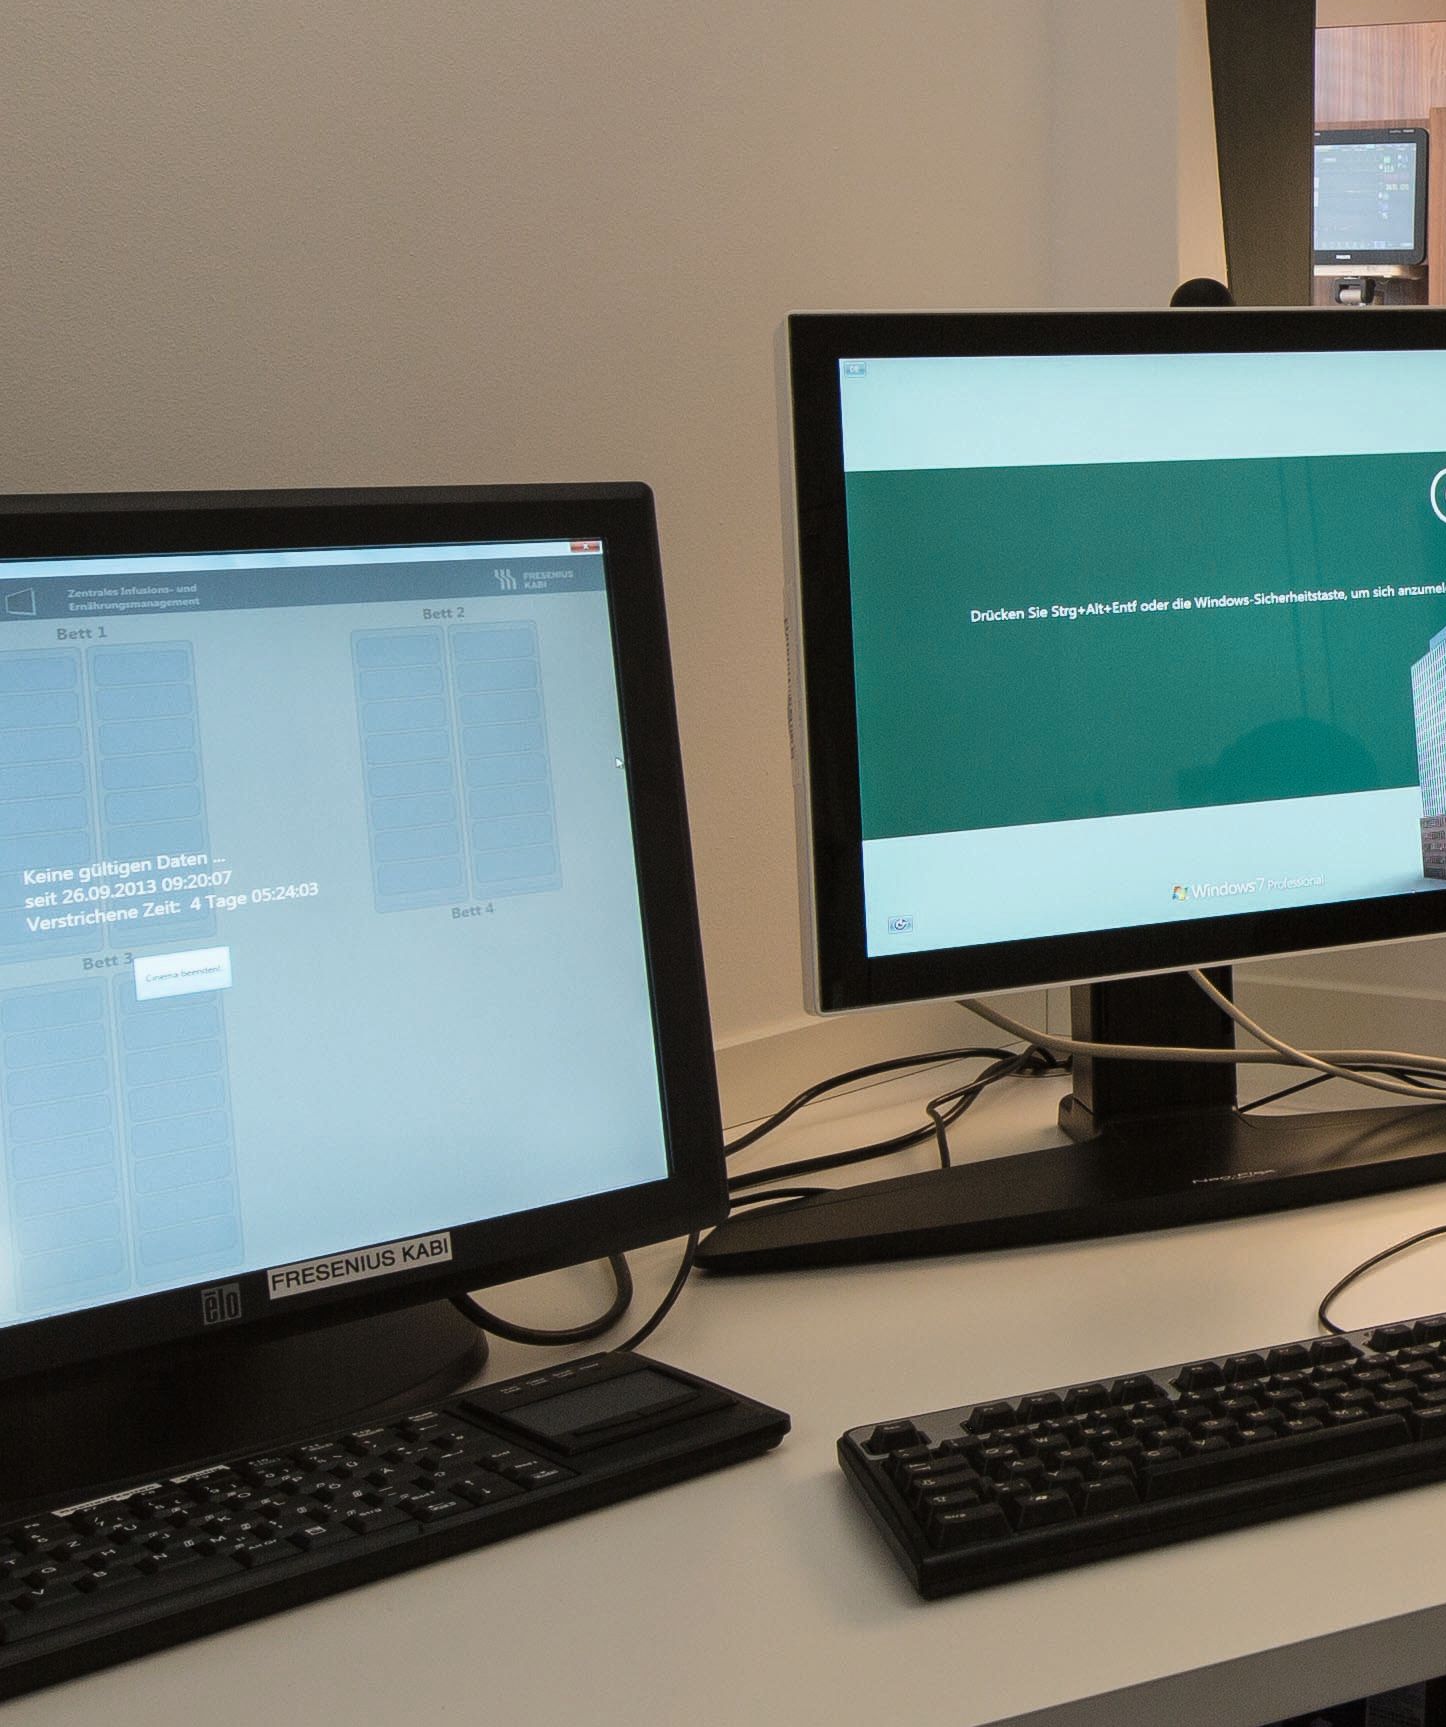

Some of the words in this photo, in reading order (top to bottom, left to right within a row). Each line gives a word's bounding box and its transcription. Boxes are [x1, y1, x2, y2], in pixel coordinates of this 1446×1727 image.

[523, 570, 574, 580] FRESENIUS
[67, 588, 119, 598] Zentrales
[120, 585, 173, 595] Infusions-
[177, 584, 197, 593] und
[525, 581, 547, 590] KABI
[69, 597, 200, 611] Ernährungsmanagement
[970, 609, 1024, 623] Drücken
[1028, 606, 1048, 619] Sie
[1051, 600, 1138, 620] Strg+Alt+Entf
[1140, 599, 1169, 612] oder
[1172, 598, 1192, 610] die
[1194, 589, 1348, 609] Windows-Sicherheitstaste,
[1351, 589, 1370, 599] um
[1373, 585, 1395, 597] sich
[423, 608, 452, 620] Bett
[457, 607, 465, 618] 2
[56, 628, 93, 640] Bett
[98, 626, 107, 638] 1
[23, 867, 73, 886] Keine
[79, 859, 152, 884] gültigen
[156, 852, 207, 870] Daten
[25, 893, 57, 909] seit
[62, 879, 156, 905] 26.09.2013
[161, 870, 232, 891] 09:20:07
[1192, 881, 1256, 899] Windows
[1268, 874, 1325, 891] Professional
[27, 905, 138, 933] Verstrichene
[142, 901, 181, 918] Zeit:
[190, 897, 202, 911] 4
[206, 891, 247, 911] Tage
[251, 881, 319, 903] 05:24:03
[452, 906, 482, 919] Bett
[486, 902, 494, 912] 4
[83, 954, 119, 971] Bett
[123, 952, 133, 965] 3
[145, 970, 179, 984] Cinema
[271, 1250, 395, 1291] FRESENIUS
[402, 1238, 448, 1263] KABI
